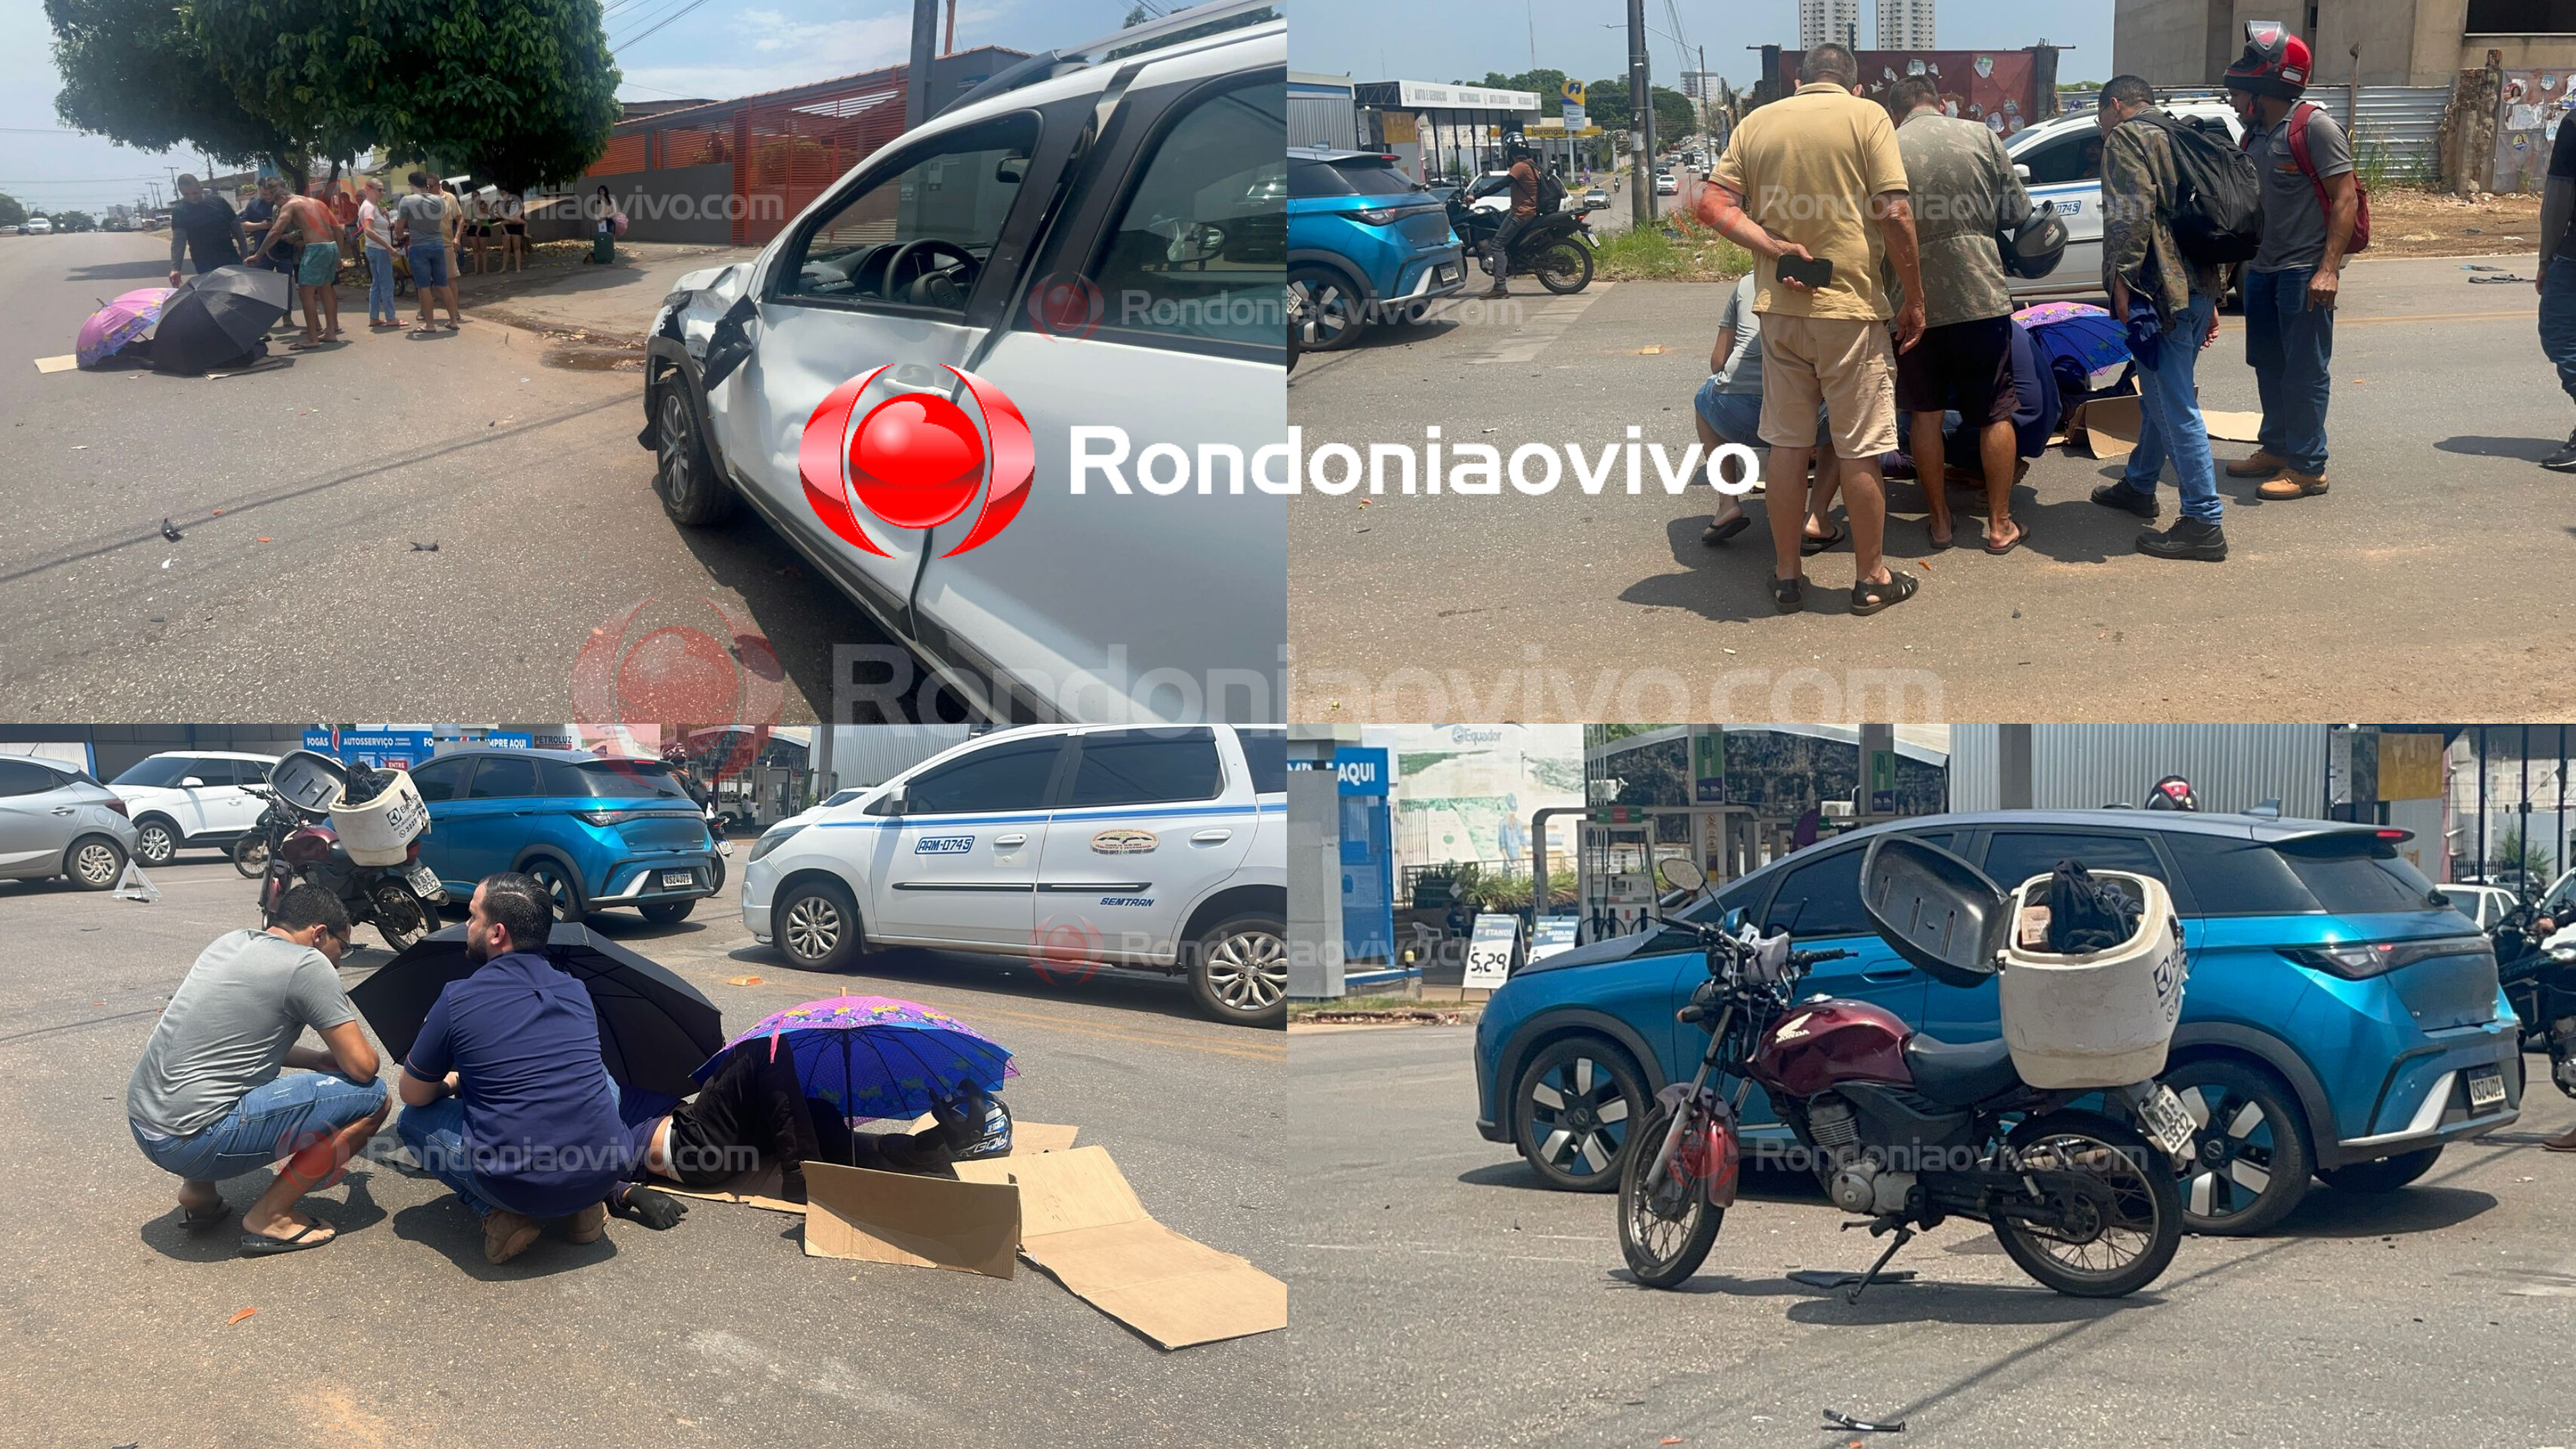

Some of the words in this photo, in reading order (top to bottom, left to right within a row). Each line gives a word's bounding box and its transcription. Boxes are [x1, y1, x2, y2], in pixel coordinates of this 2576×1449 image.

[1531, 128, 1563, 137] Ipiranga
[343, 737, 393, 749] AUTOSSERVIÇO
[534, 736, 572, 744] PETROLUZ
[1464, 728, 1502, 746] Equador
[509, 739, 527, 748] AQUI
[1337, 763, 1375, 786] AQUI
[417, 879, 439, 896] 5932
[1100, 897, 1155, 906] SEMTRAN
[1485, 928, 1513, 937] ETANOL
[1470, 952, 1507, 974] 5,29
[2162, 1112, 2194, 1149] 5932
